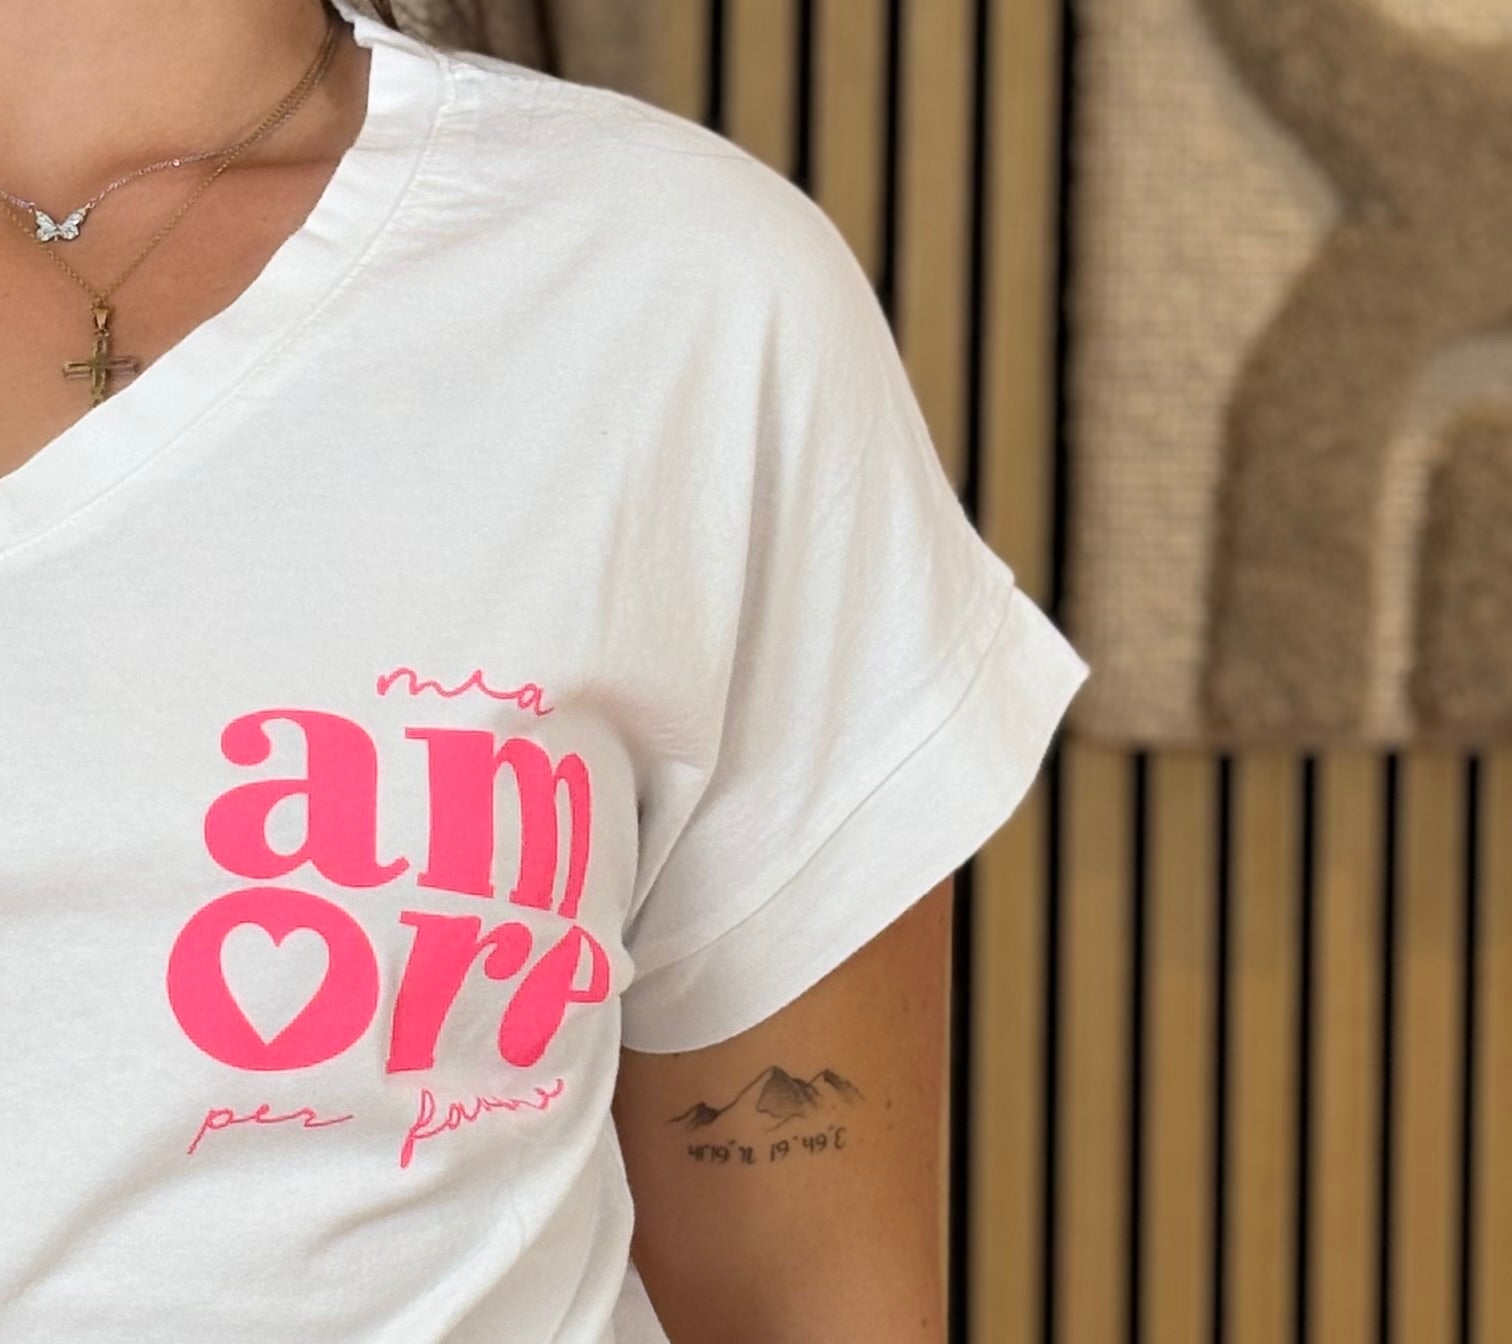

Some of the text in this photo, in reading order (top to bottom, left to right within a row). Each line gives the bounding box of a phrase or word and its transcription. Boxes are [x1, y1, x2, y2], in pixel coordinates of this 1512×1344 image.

[375, 666, 555, 718] mia
[203, 707, 593, 920] am
[165, 884, 613, 1076] ore
[187, 1103, 356, 1154] per
